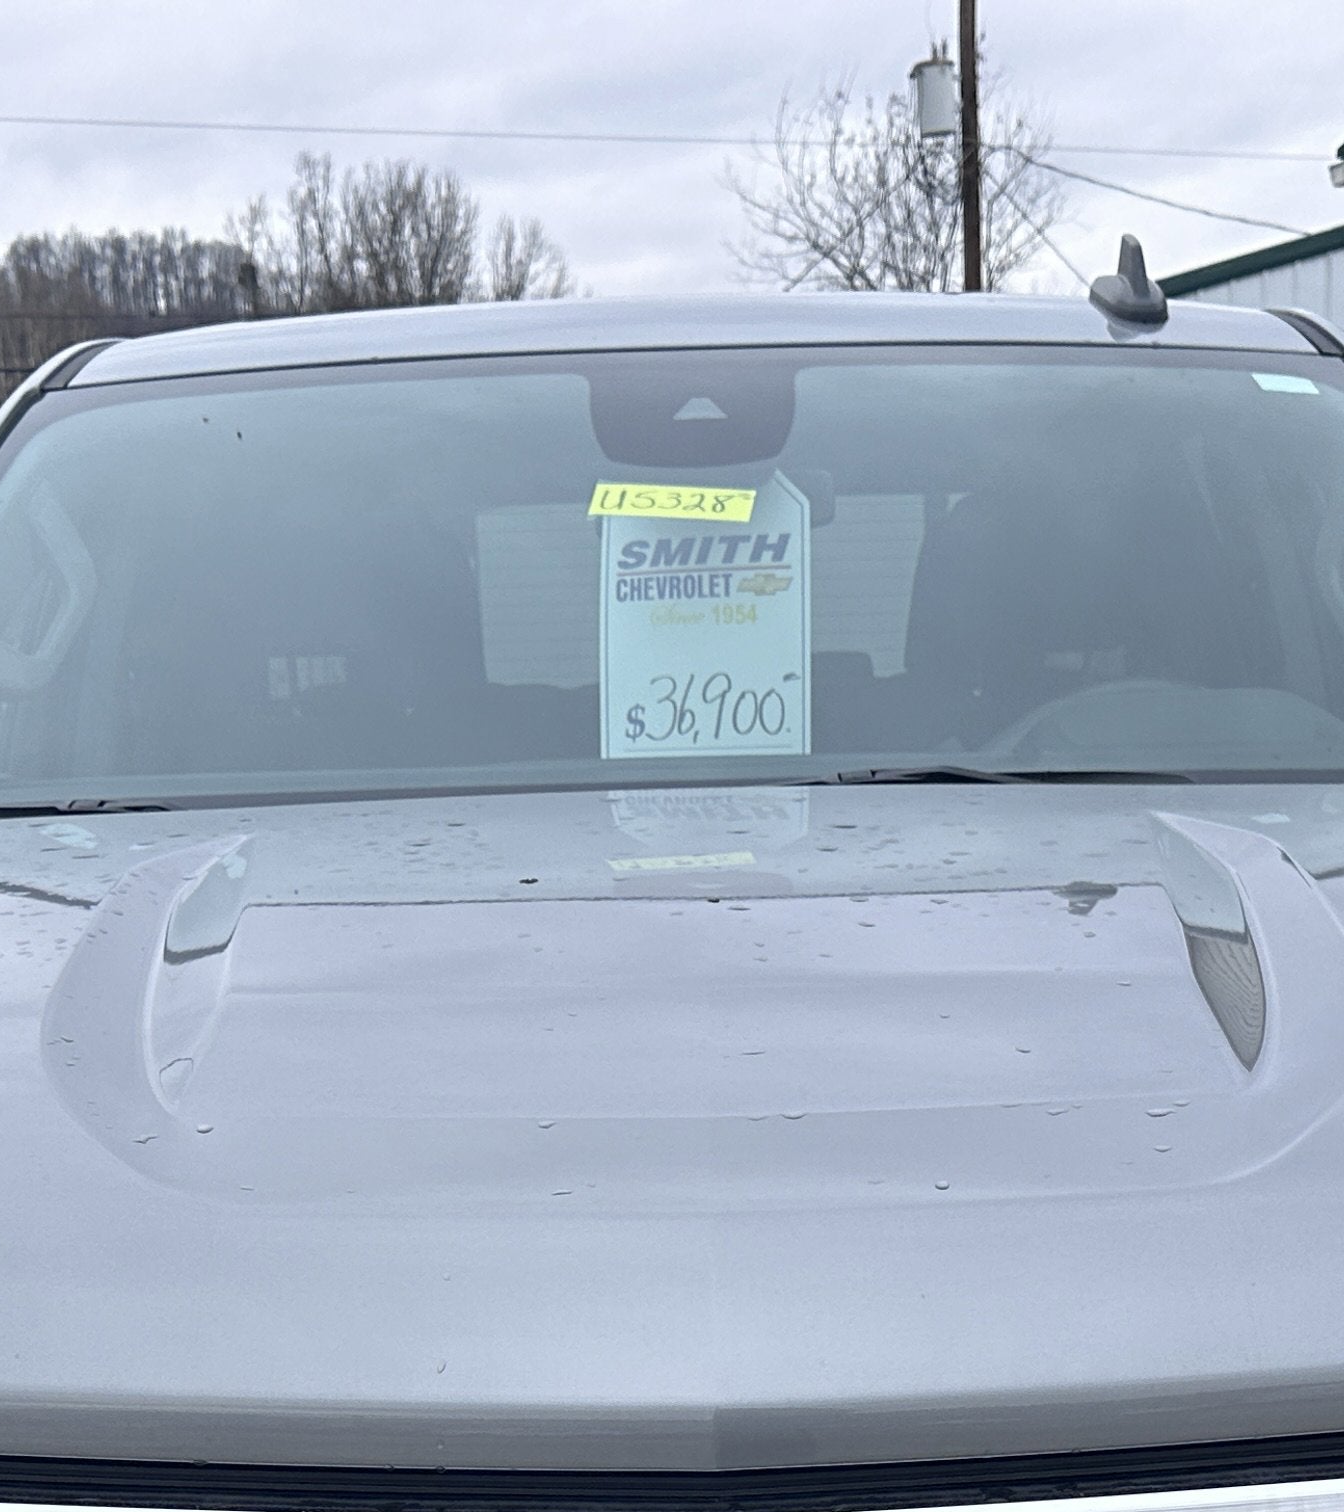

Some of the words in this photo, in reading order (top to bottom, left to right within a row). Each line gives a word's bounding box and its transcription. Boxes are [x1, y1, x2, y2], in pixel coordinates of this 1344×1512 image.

[616, 532, 792, 570] SMITH
[615, 573, 733, 602] CHEVROLET
[712, 603, 758, 625] 1954
